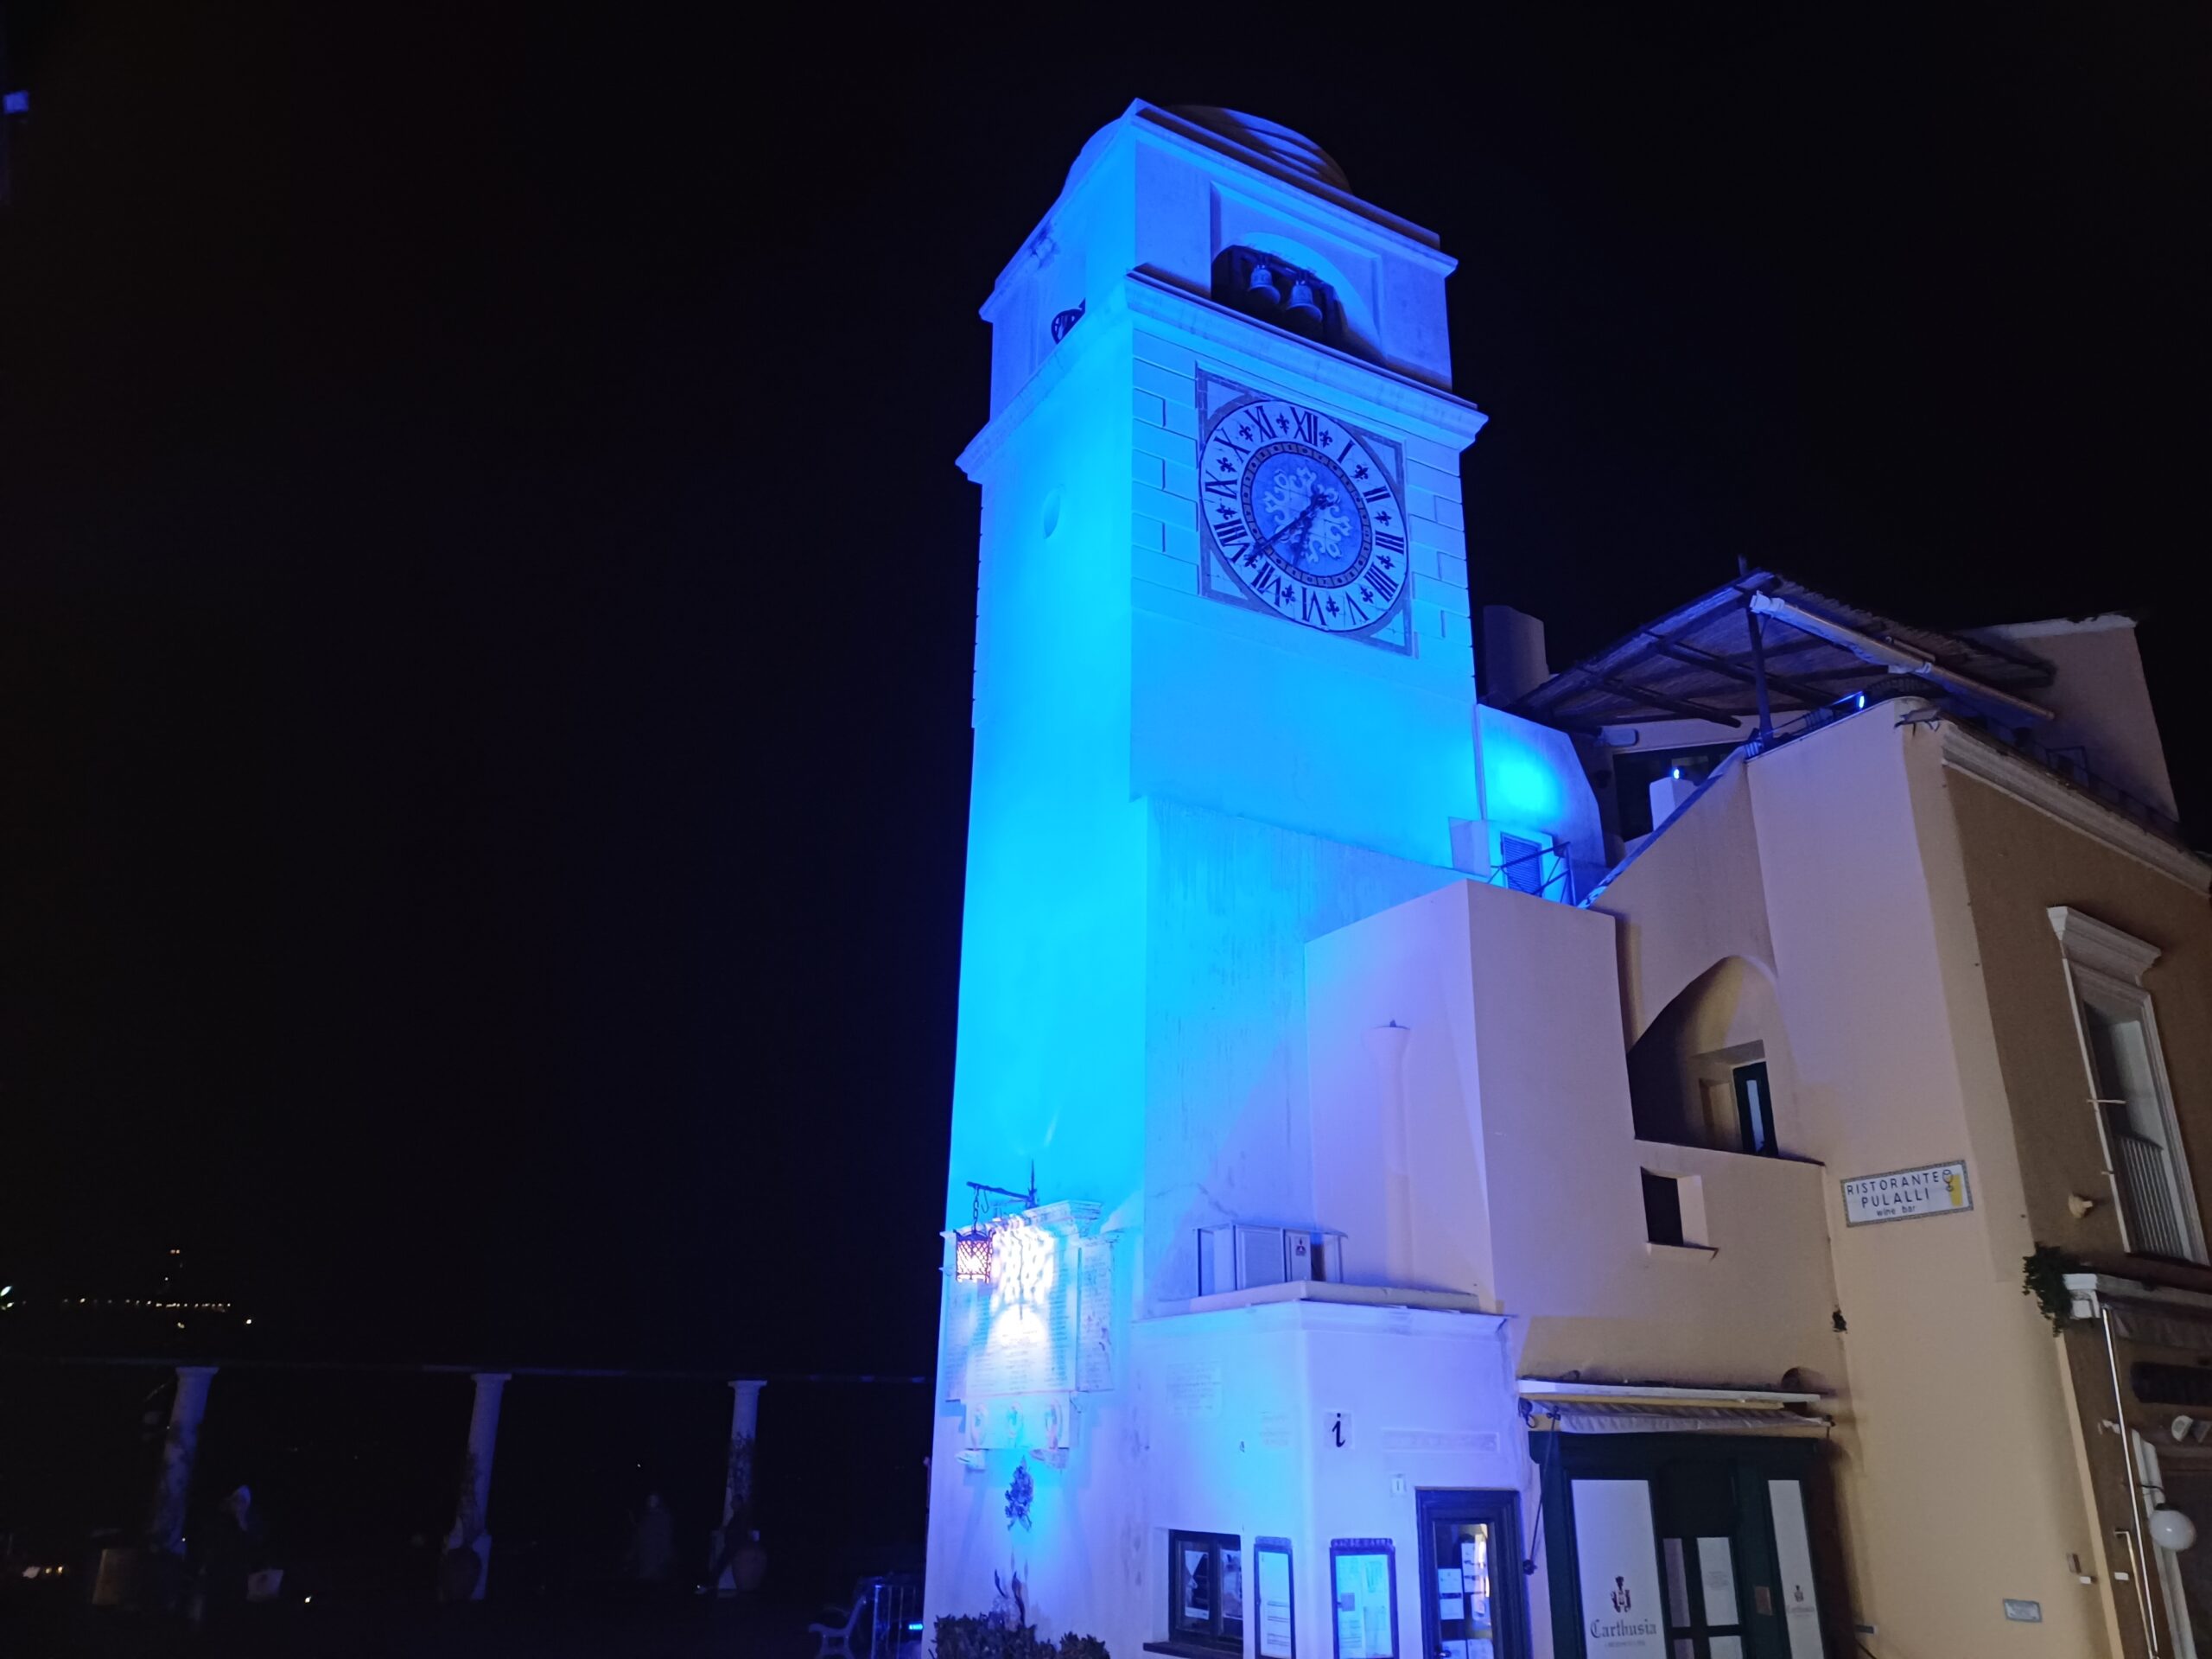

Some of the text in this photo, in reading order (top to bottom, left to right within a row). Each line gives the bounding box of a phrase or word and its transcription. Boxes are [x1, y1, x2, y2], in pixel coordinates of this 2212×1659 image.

[1247, 405, 1276, 442] XI
[1291, 407, 1319, 445] XII
[1214, 429, 1249, 462] X
[1338, 441, 1354, 462] I
[1205, 471, 1237, 499] IX
[1363, 486, 1391, 503] II
[1213, 519, 1249, 563] VIII
[1376, 531, 1404, 554] III
[1251, 562, 1281, 606] VII
[1364, 566, 1398, 601] IIII
[1301, 588, 1326, 626] VI
[1344, 593, 1369, 624] V
[1847, 1171, 1940, 1195] RISTORANTE
[1862, 1187, 1929, 1208] PULALLI
[1876, 1205, 1916, 1216] wine bar
[1332, 1413, 1345, 1447] i
[1590, 1618, 1656, 1638] Carthusia
